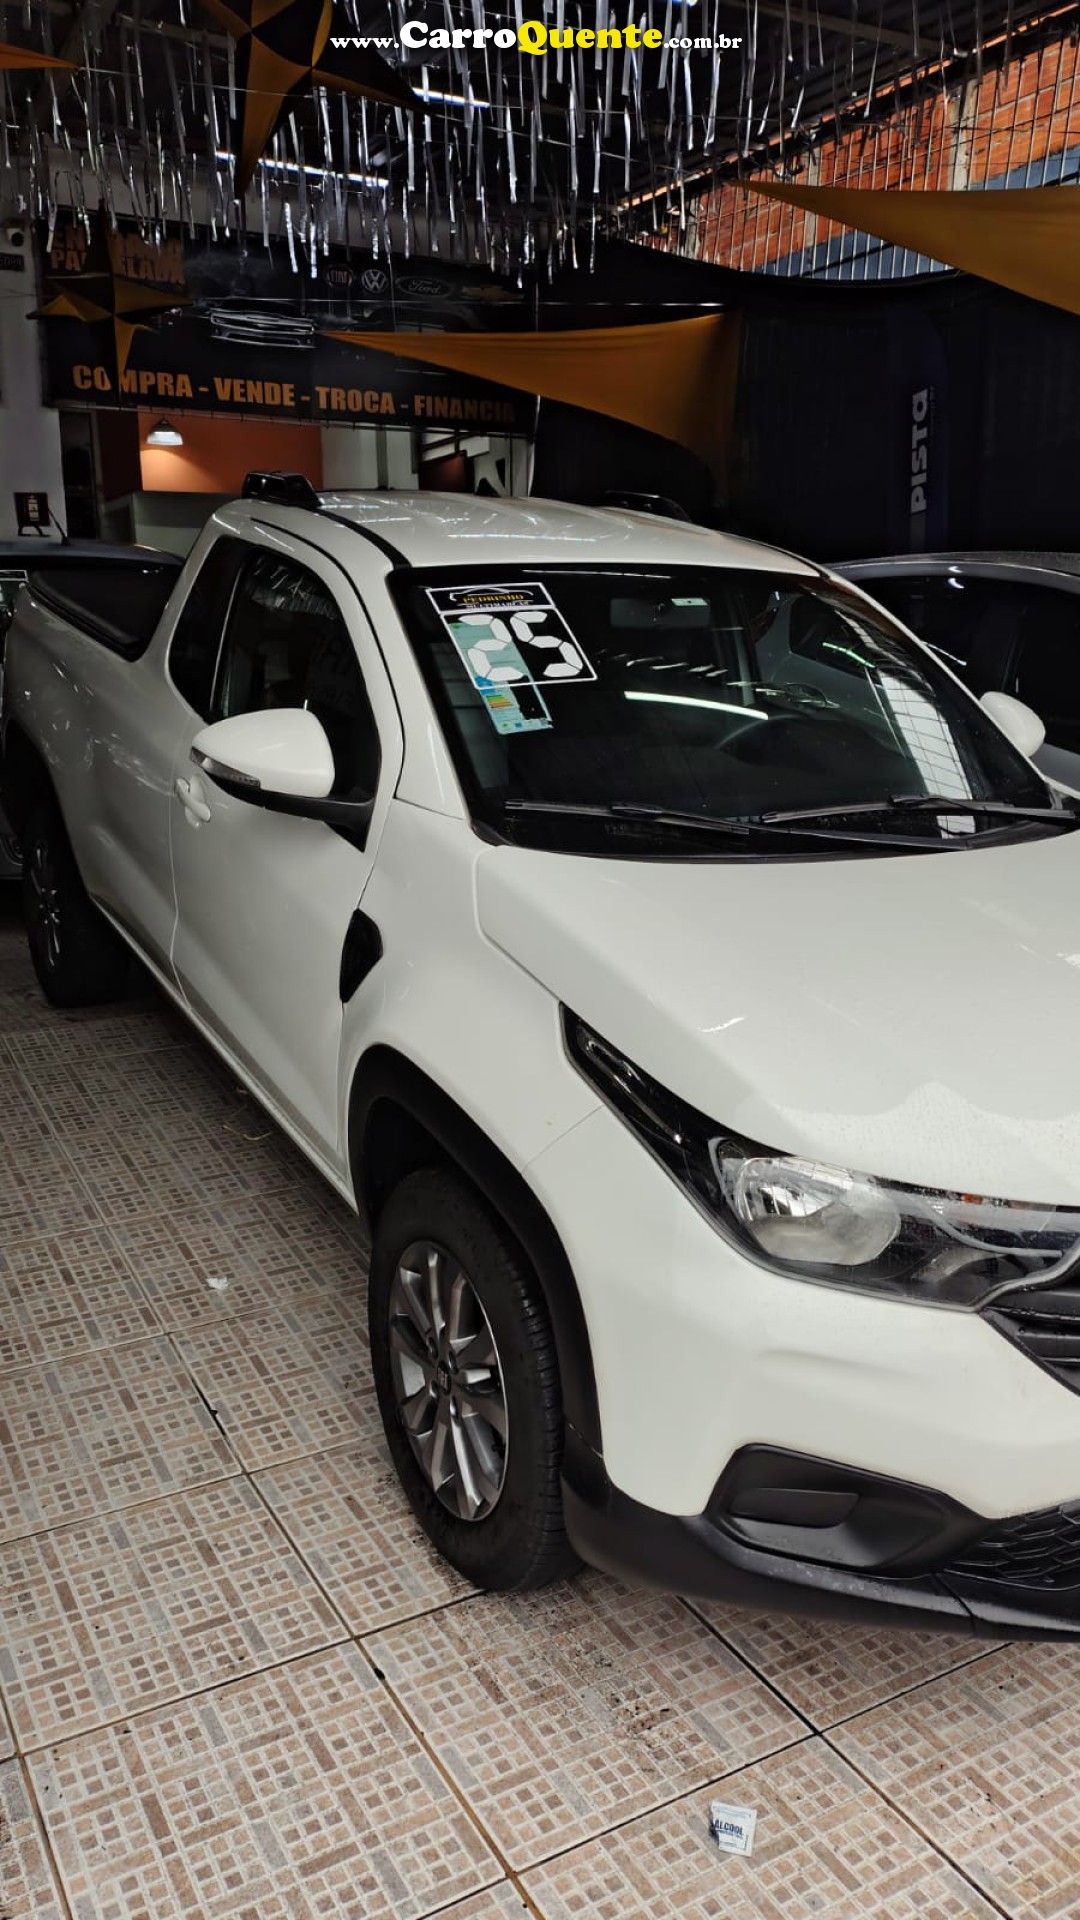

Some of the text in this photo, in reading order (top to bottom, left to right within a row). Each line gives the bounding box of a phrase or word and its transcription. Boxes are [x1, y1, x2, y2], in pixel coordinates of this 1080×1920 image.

[72, 363, 193, 398] COMPRA
[212, 376, 295, 406] VENDE
[315, 385, 396, 414] TROCA
[413, 395, 516, 424] FINANCIA
[458, 611, 583, 682] 25
